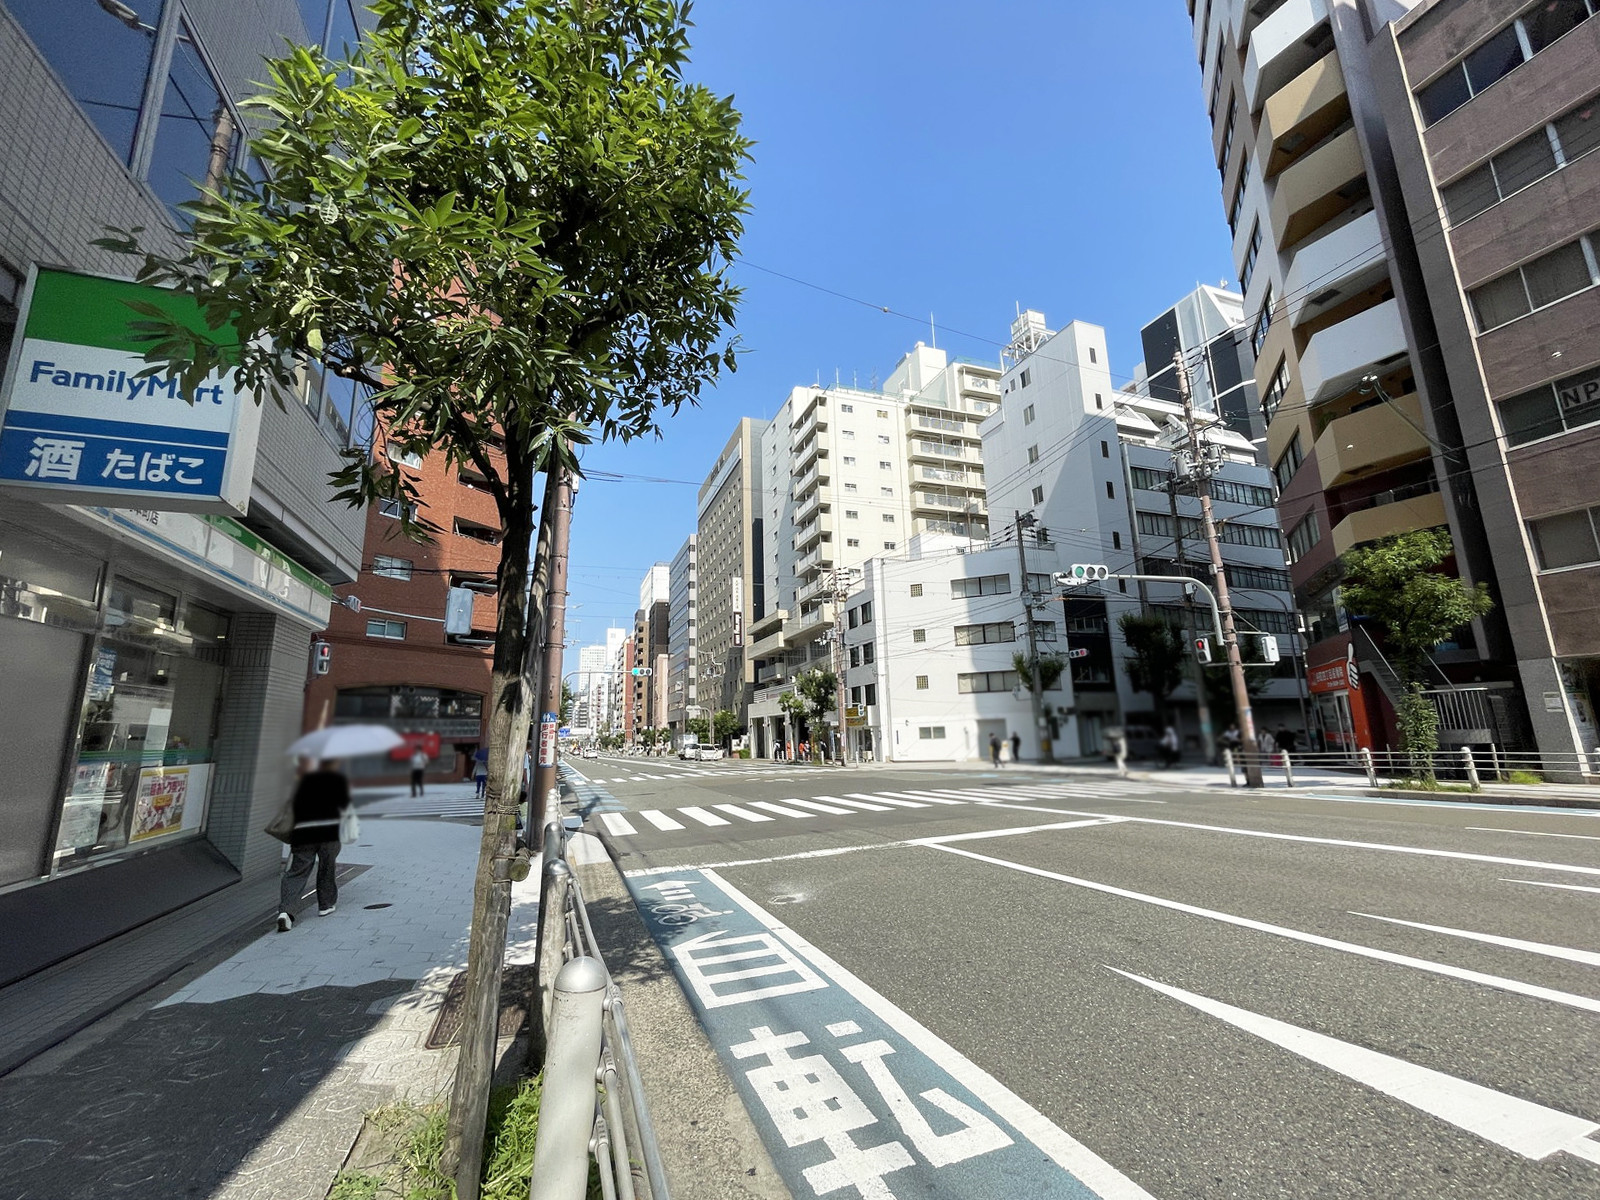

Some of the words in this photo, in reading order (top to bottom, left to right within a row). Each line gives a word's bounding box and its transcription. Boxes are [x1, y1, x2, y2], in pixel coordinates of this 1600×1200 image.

[24, 436, 86, 482] 酒
[100, 447, 204, 486] たばこ
